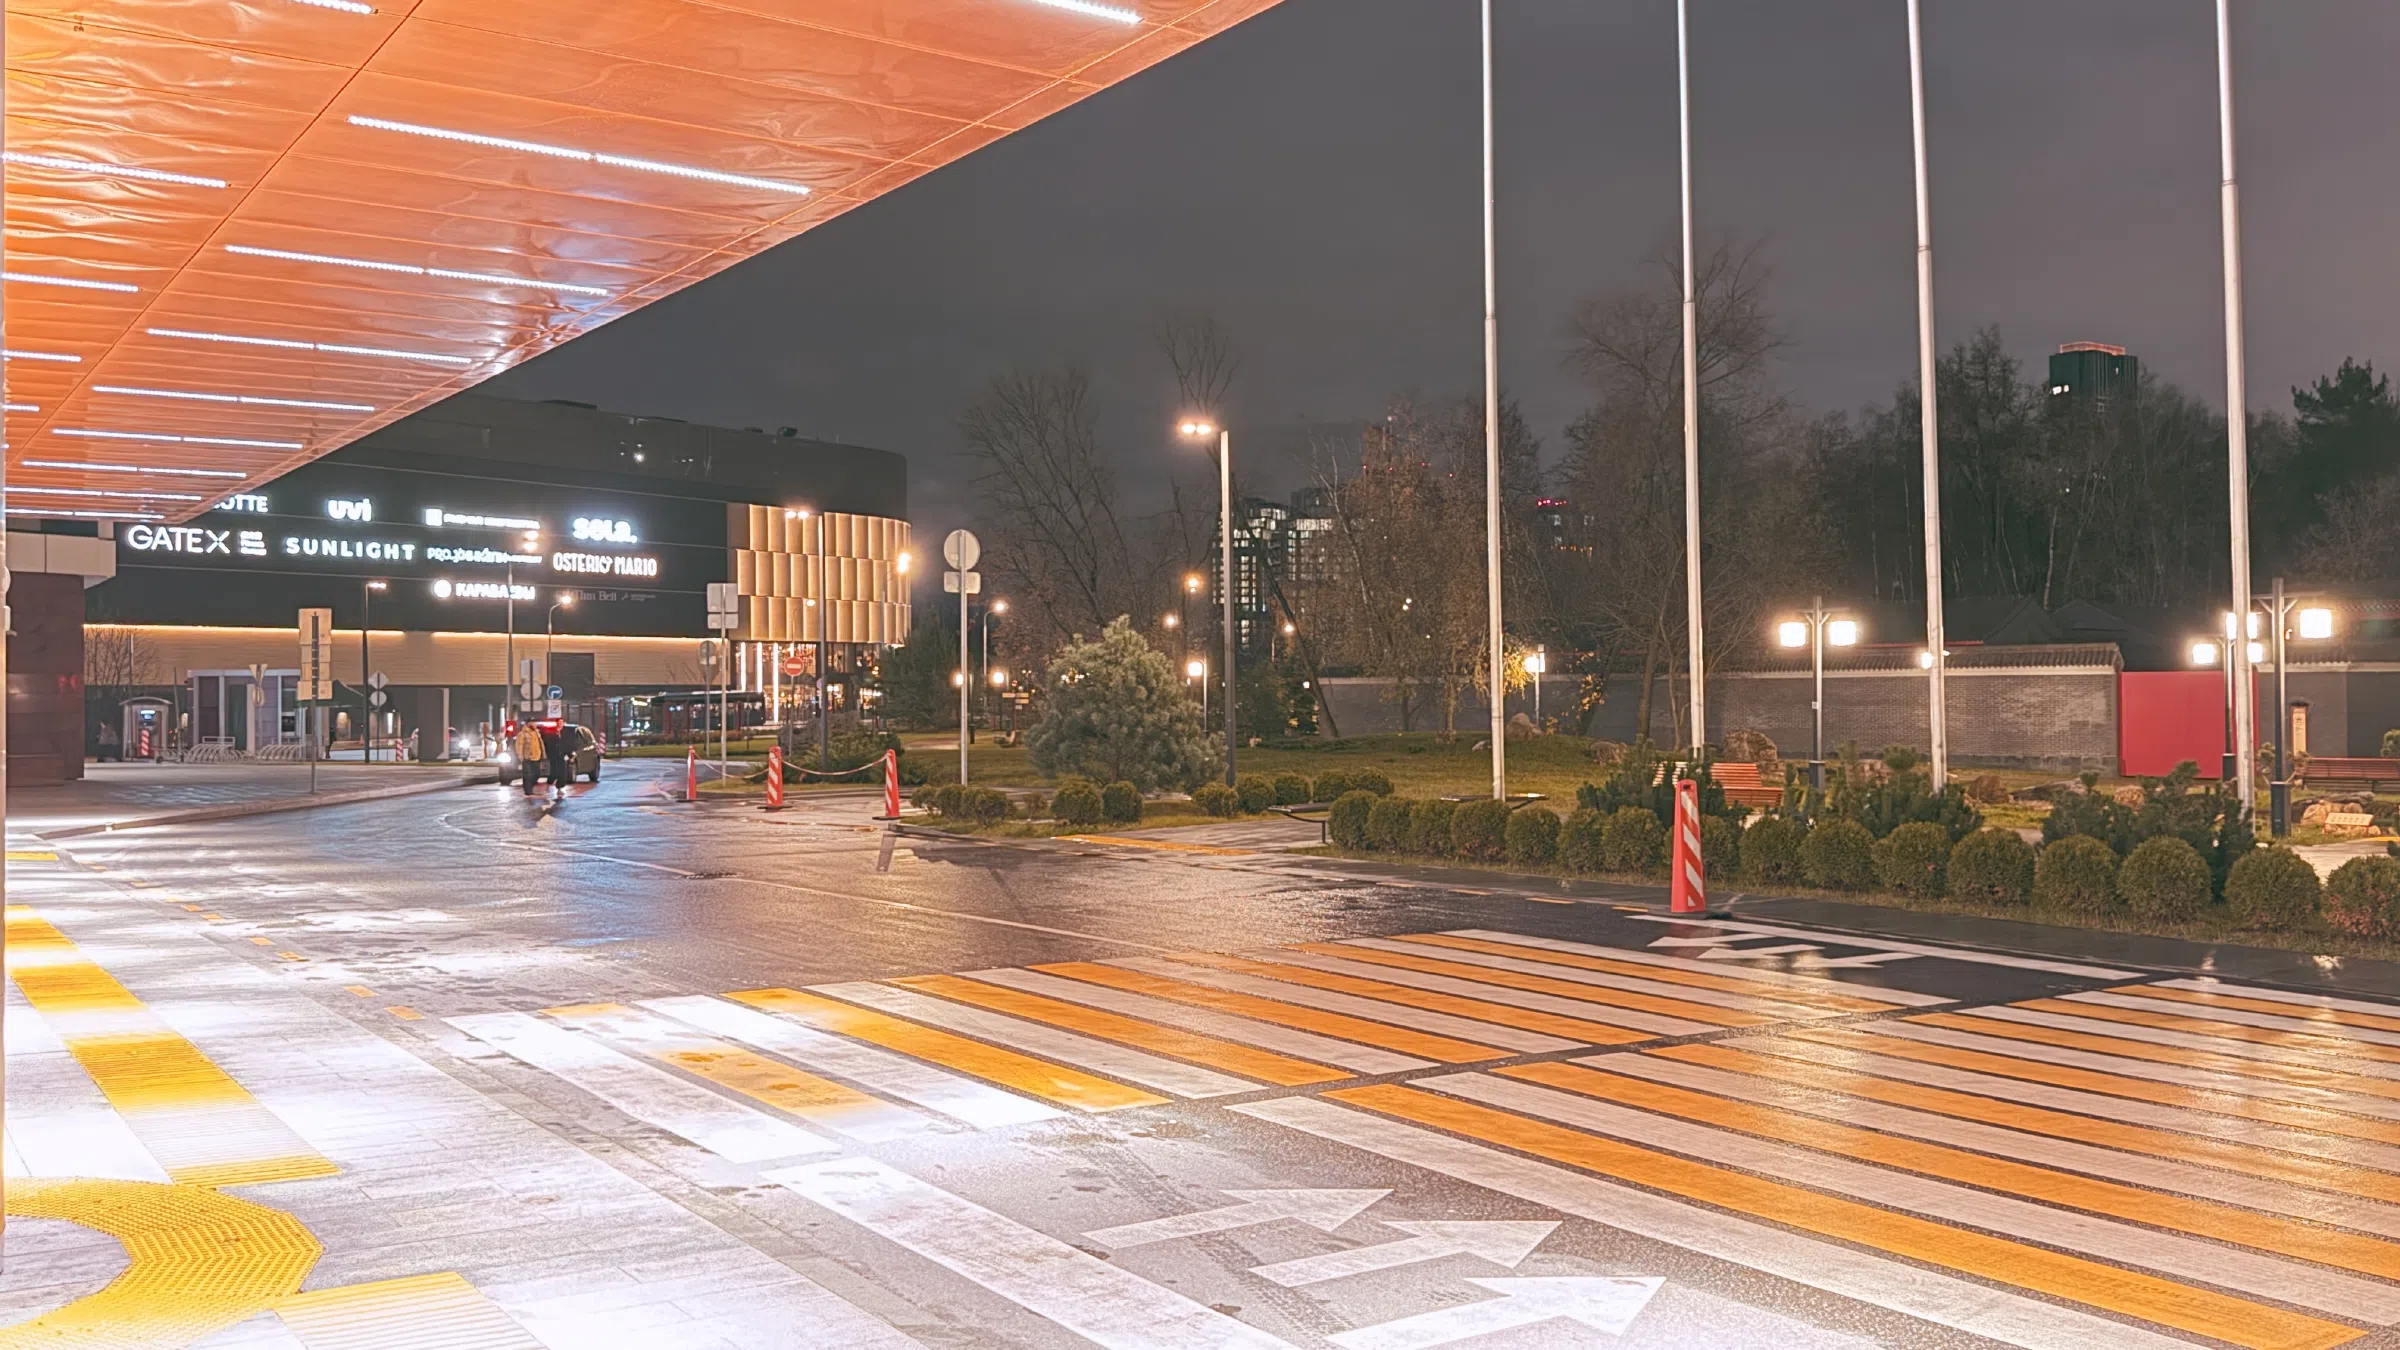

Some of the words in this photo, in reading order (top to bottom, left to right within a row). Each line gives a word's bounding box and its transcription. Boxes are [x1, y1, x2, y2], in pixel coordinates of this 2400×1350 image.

[128, 524, 230, 554] GATEX
[286, 537, 416, 561] SUNLIGHT
[614, 556, 657, 577] MARIO
